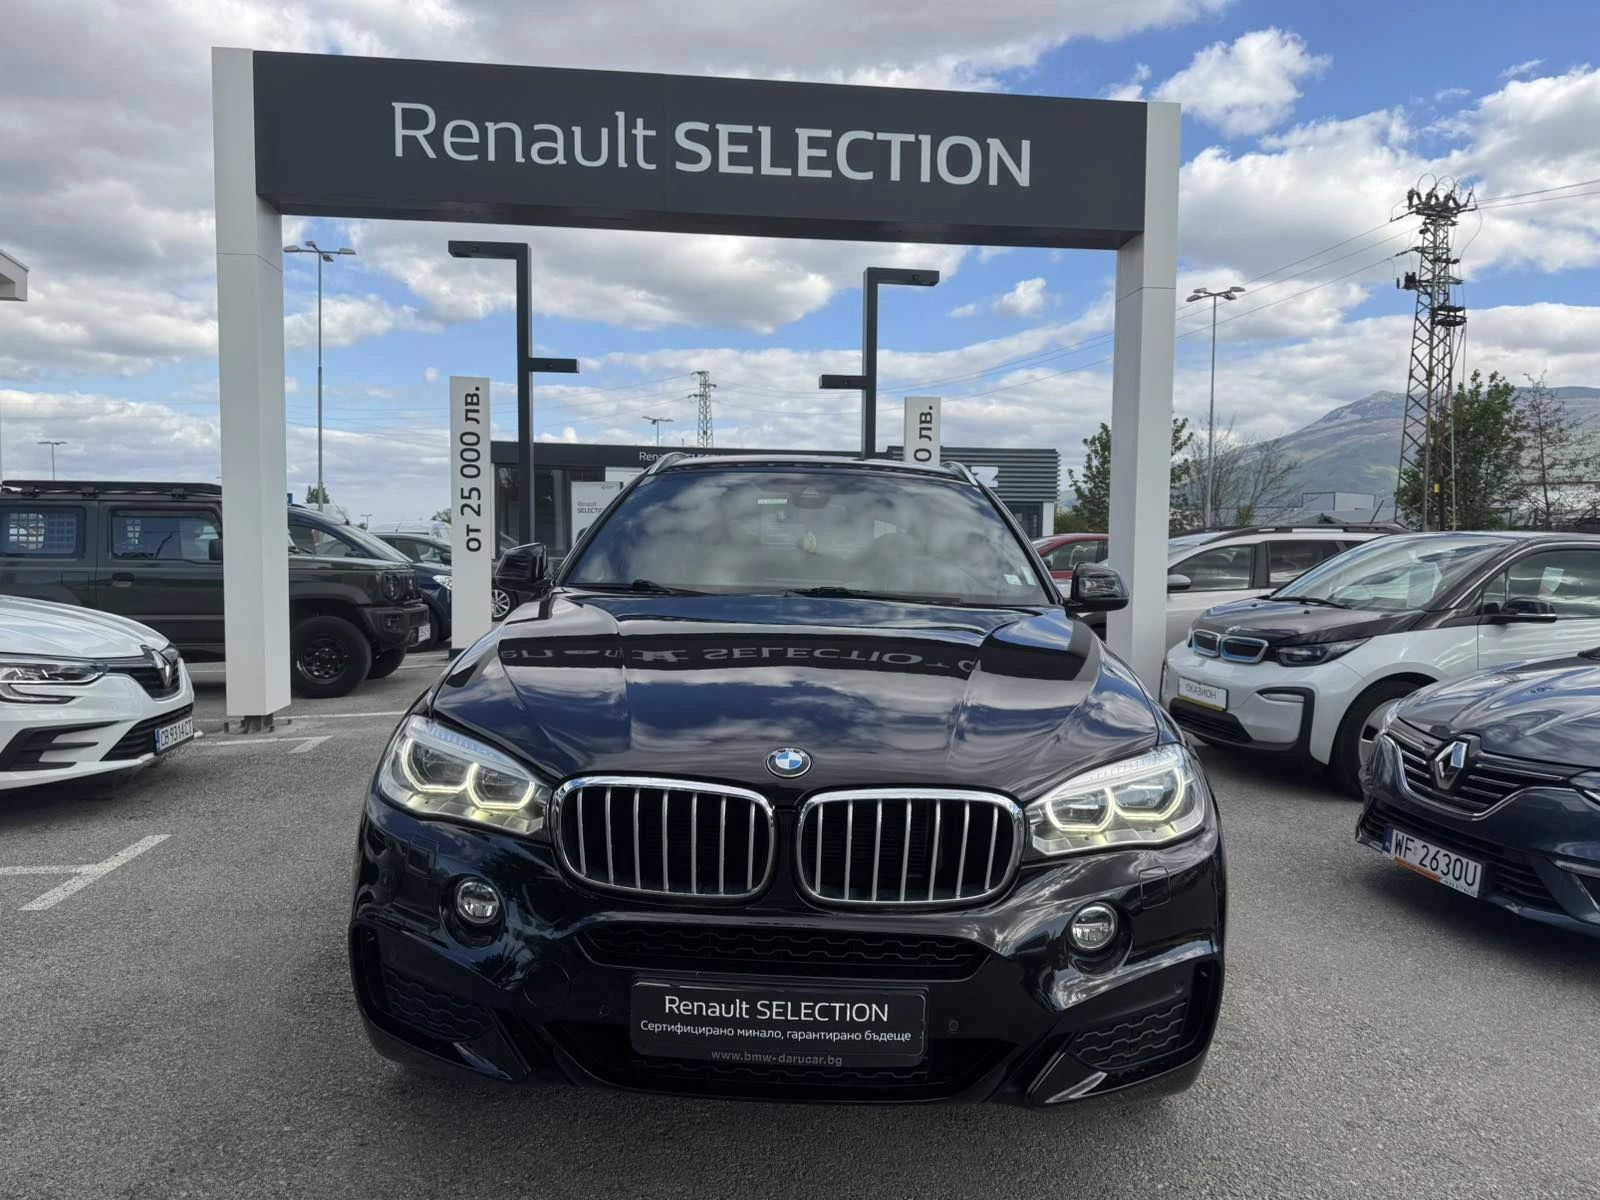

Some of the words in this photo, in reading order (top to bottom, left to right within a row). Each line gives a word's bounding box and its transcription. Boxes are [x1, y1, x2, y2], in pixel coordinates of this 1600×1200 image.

[391, 101, 657, 170] Renault
[674, 121, 1031, 188] SELECTION
[459, 431, 481, 479] 000
[460, 486, 481, 517] 25
[1395, 832, 1415, 858] WF
[1419, 844, 1478, 887] 2630U
[664, 995, 750, 1019] Renault
[756, 1000, 889, 1023] SELECTION
[640, 1020, 735, 1037] Сертифицирано
[737, 1028, 784, 1040] минало,
[786, 1030, 862, 1043] гарантирано
[864, 1030, 912, 1043] бъдеще
[711, 1050, 843, 1067] www.bmw-darucar.bg
